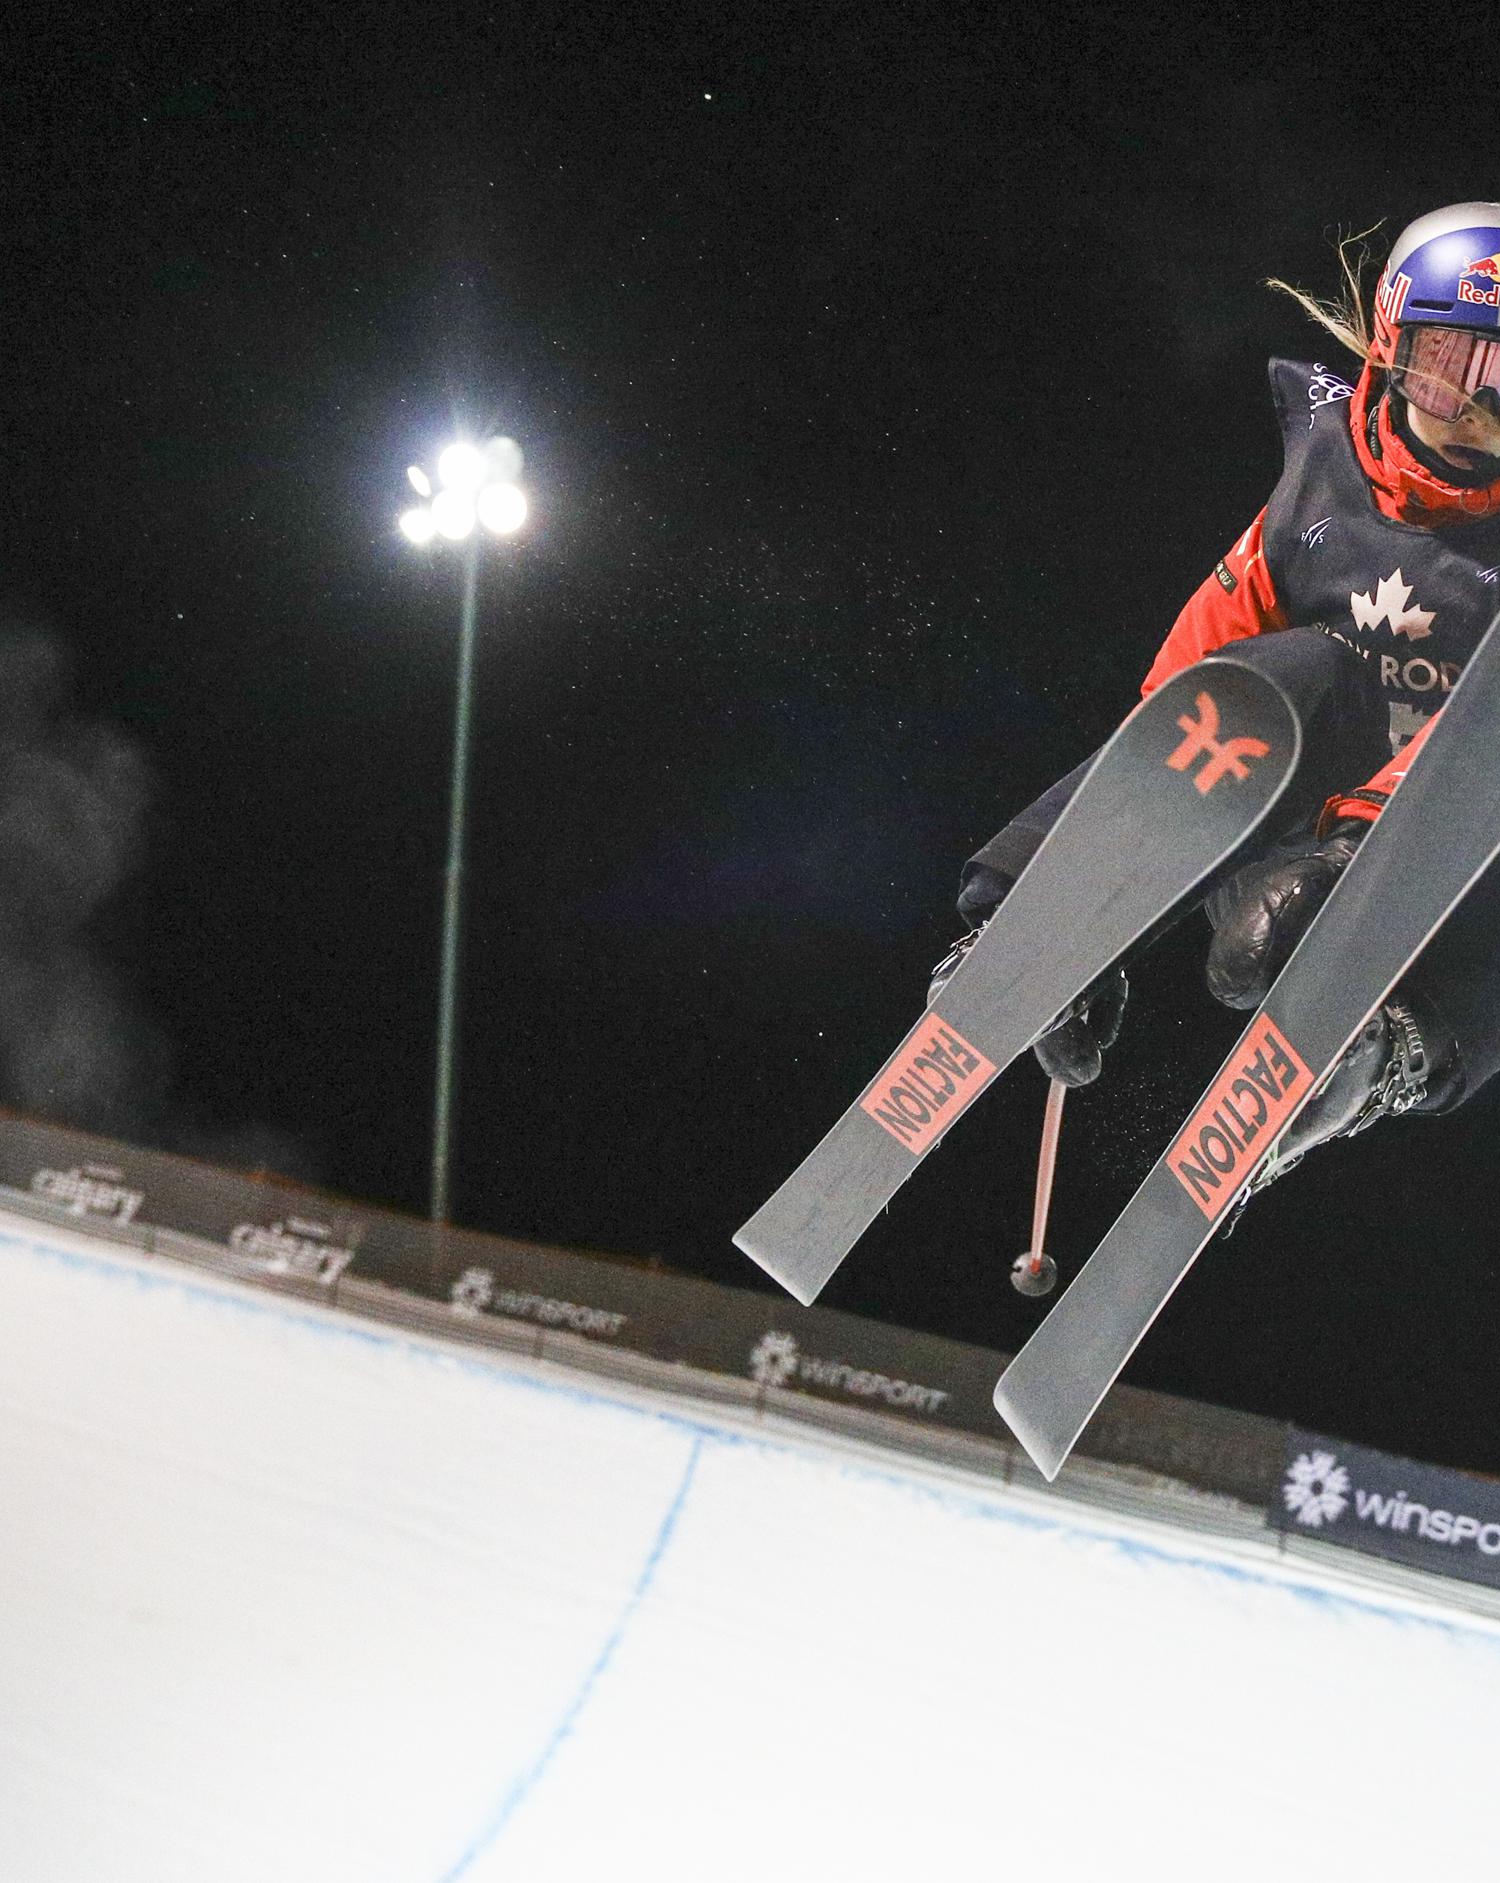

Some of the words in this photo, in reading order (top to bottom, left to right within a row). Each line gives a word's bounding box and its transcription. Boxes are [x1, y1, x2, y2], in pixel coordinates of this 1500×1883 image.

[1458, 279, 1500, 307] Red
[874, 1027, 980, 1143] FACTION
[1178, 1031, 1300, 1204] FACTION
